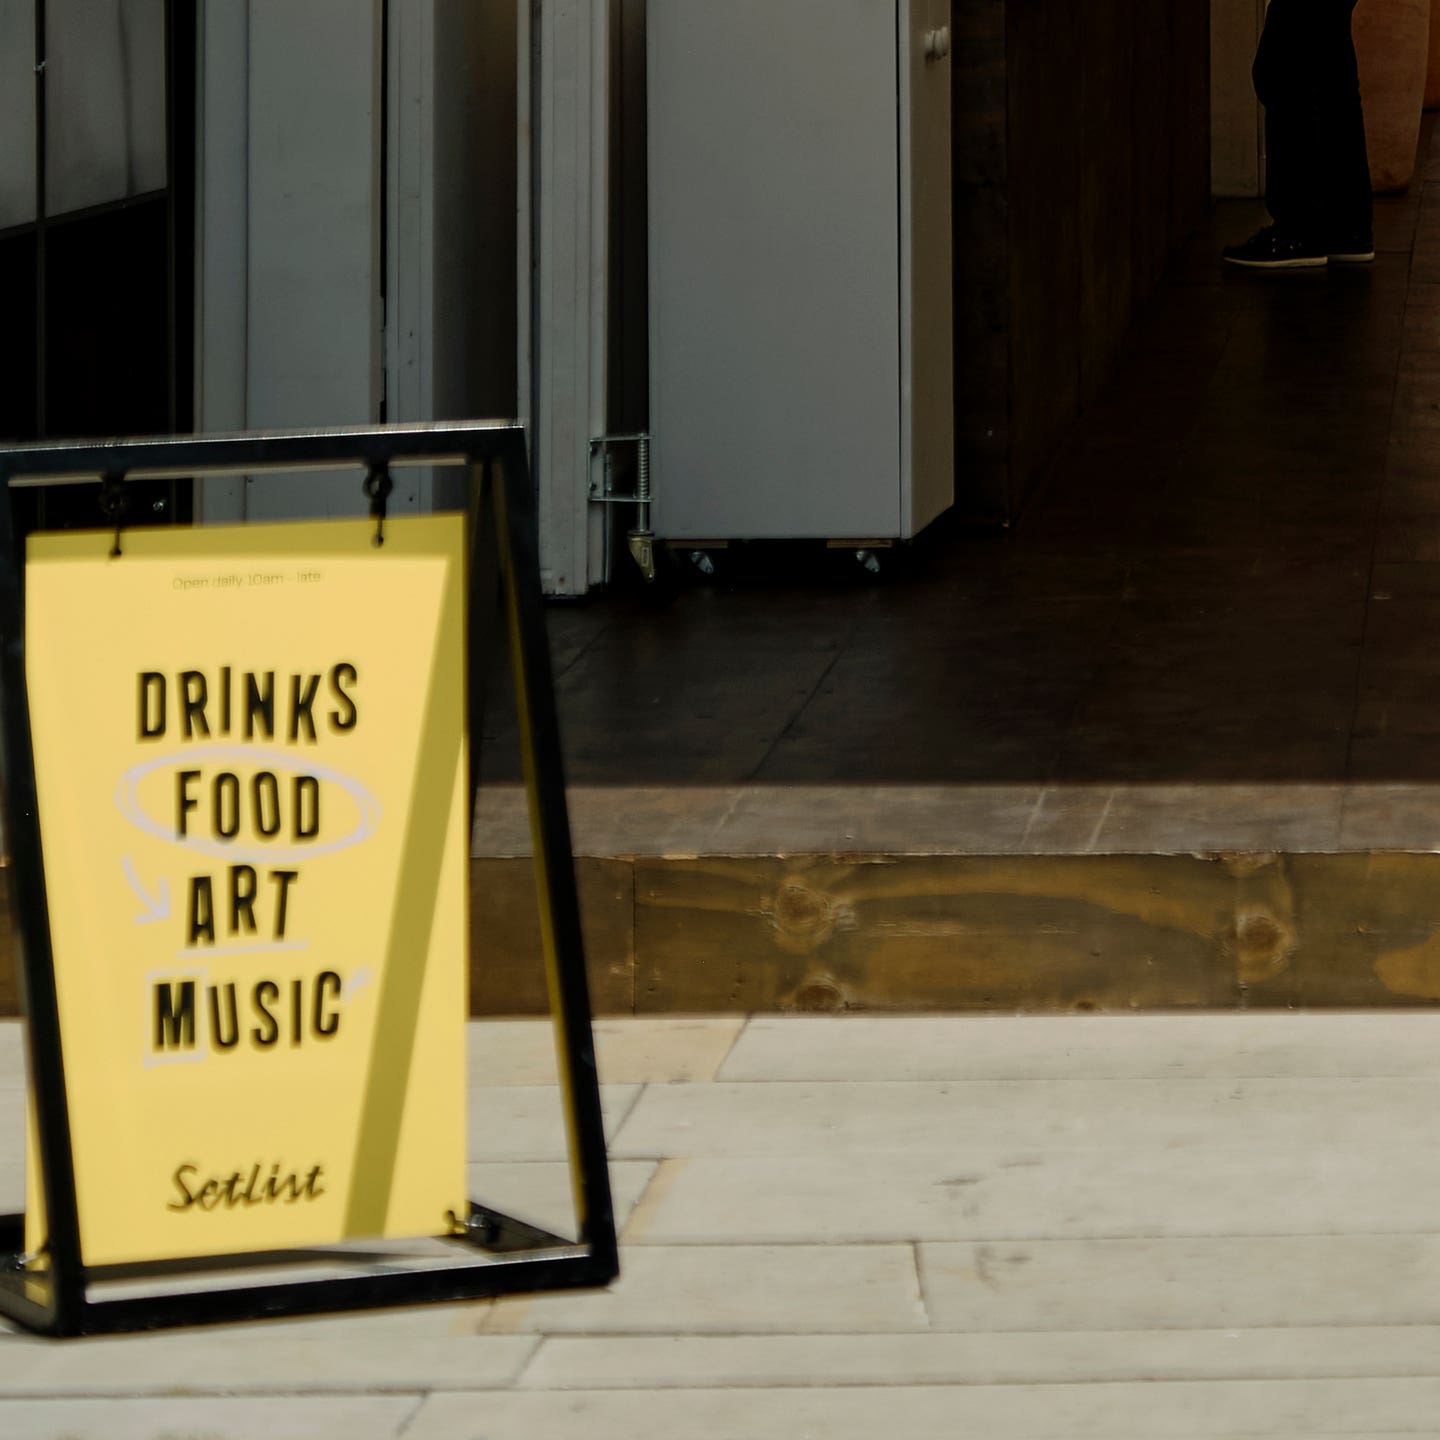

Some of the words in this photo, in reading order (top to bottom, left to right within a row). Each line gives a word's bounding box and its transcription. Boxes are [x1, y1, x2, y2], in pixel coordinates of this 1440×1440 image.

[172, 577, 209, 590] Open
[212, 574, 243, 588] daily
[247, 573, 284, 586] 10am
[296, 570, 321, 583] late
[136, 663, 358, 745] DRINKS
[175, 769, 320, 843] FOOD
[184, 864, 299, 949] ART
[152, 970, 343, 1055] MUSIC
[165, 1163, 326, 1213] Setlist
